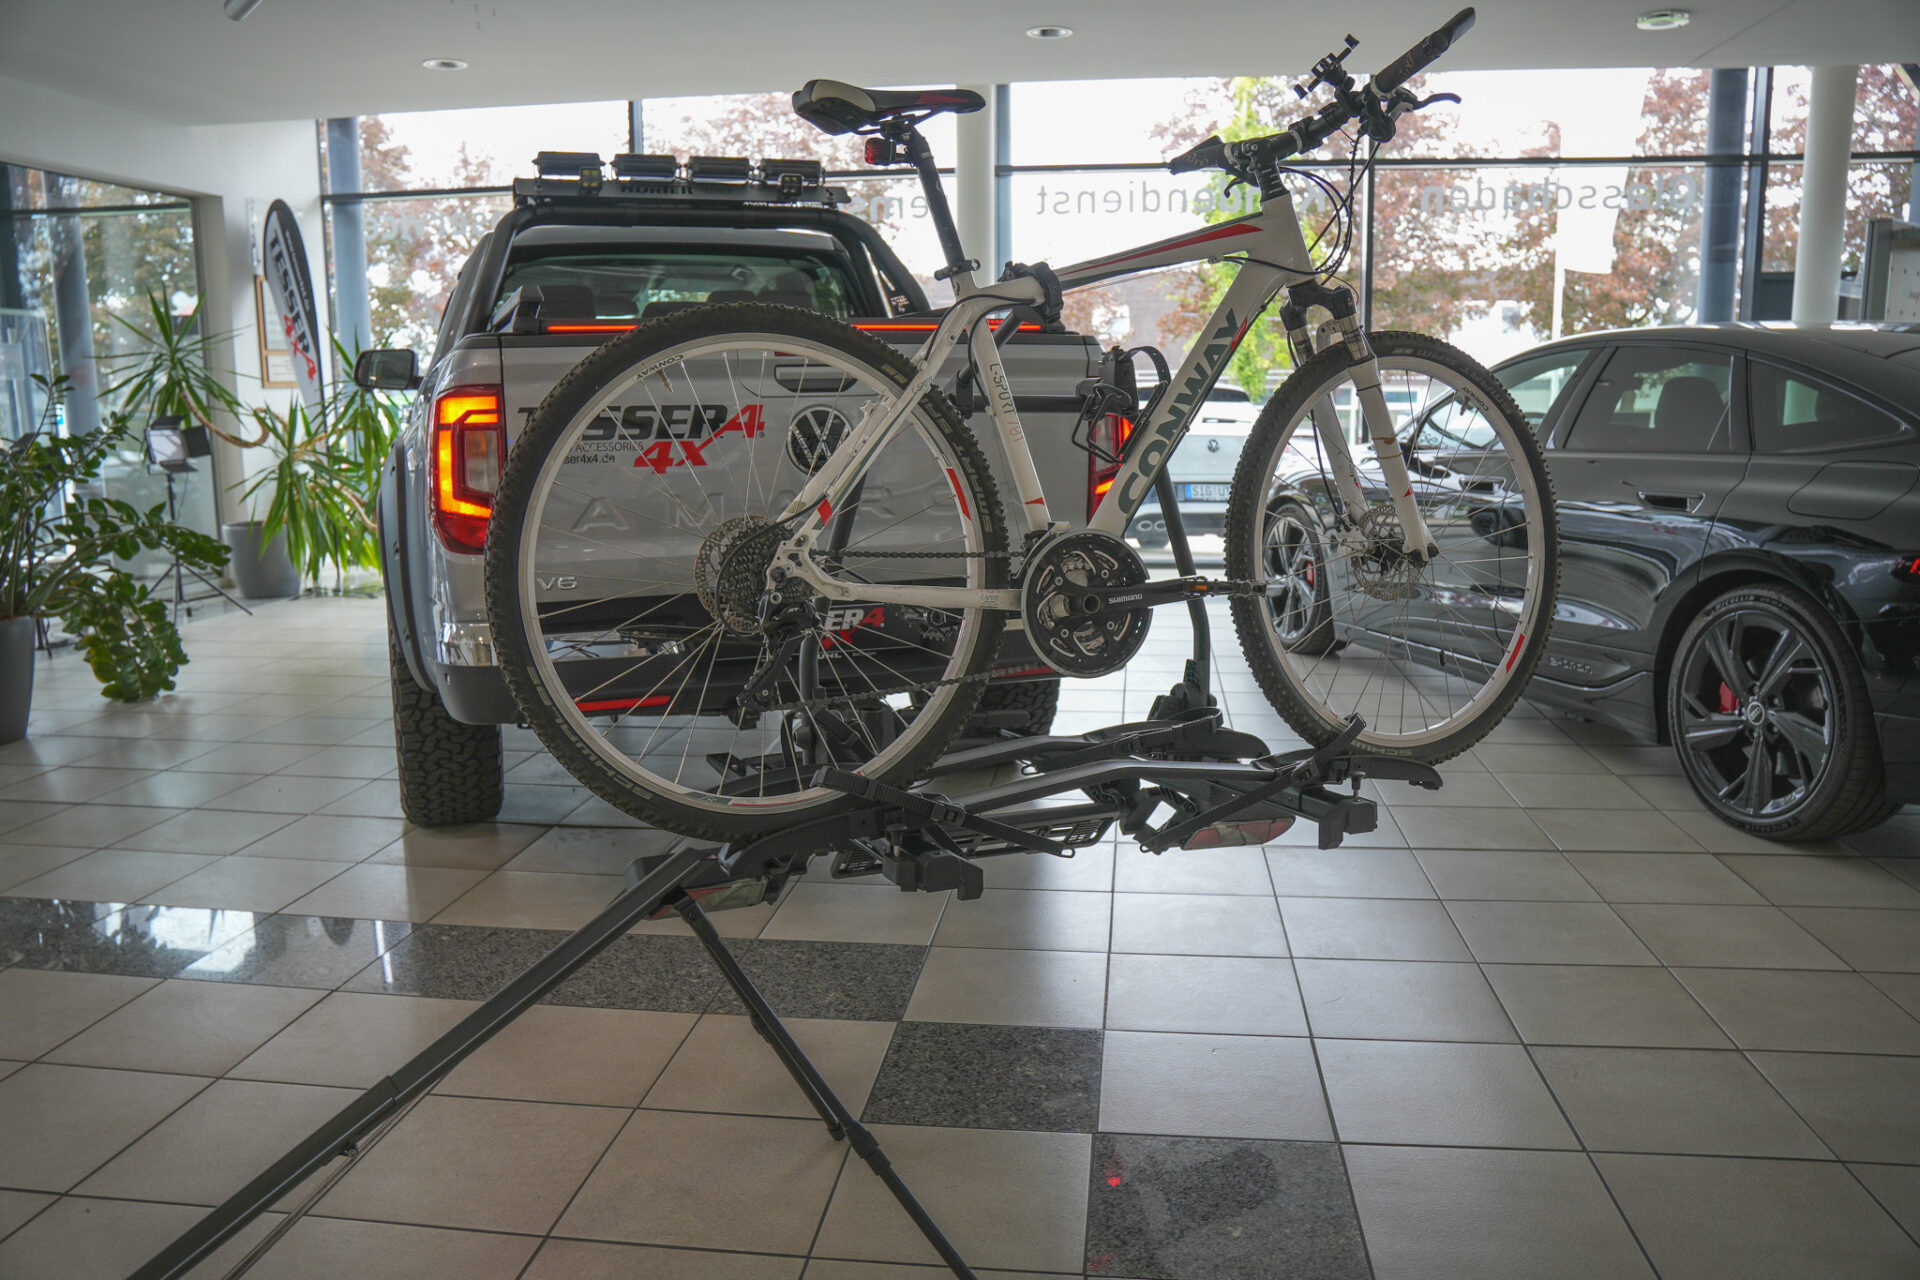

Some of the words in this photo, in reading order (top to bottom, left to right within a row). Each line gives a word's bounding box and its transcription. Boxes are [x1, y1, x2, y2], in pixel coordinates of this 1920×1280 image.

[270, 229, 310, 353] TESSER
[635, 354, 684, 381] CONWAY
[1118, 307, 1241, 514] CONWAY
[516, 403, 729, 440] TSSER
[575, 441, 645, 453] ACCESSORIES
[563, 452, 616, 466] ser4x4.de
[1192, 485, 1213, 497] SIG
[537, 576, 579, 591] V6
[1108, 593, 1143, 604] SHIMANO
